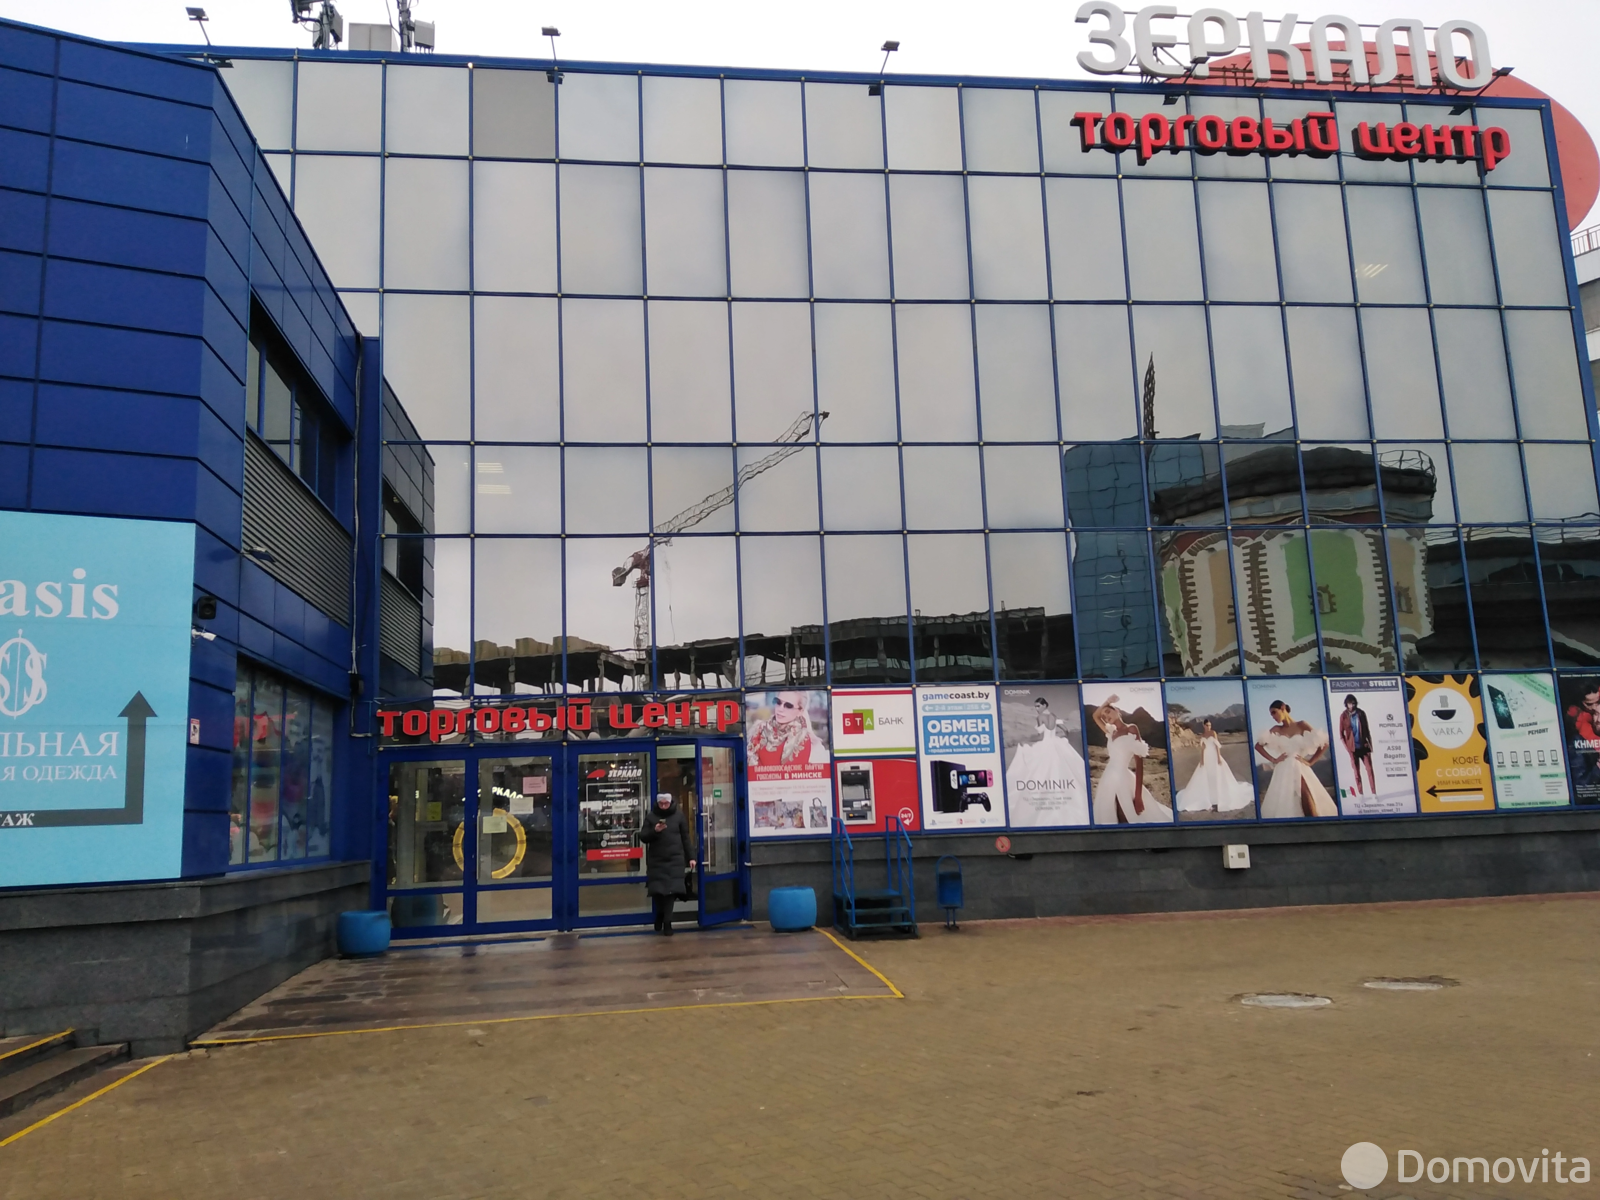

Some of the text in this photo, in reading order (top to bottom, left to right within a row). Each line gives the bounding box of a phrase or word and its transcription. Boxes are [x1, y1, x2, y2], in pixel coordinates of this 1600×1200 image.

[1075, 1, 1493, 91] ЗЕРКАЛО
[1368, 679, 1396, 687] STREET
[922, 691, 990, 702] gamecoast.by
[844, 717, 904, 727] БТА БАНК
[927, 718, 990, 733] ОБМЕН
[1432, 727, 1464, 736] VARKA
[928, 734, 991, 748] ДИСКОВ
[1574, 739, 1600, 749] KHME
[1383, 752, 1407, 760] Bagatto
[1452, 756, 1479, 765] КОФЕ
[22, 765, 118, 783] ОДЕЖДА
[607, 768, 643, 778] ЗЕРКАЛО
[791, 771, 822, 779] МИНСКЕ
[1436, 765, 1482, 777] С СОБОЙ
[1016, 779, 1076, 791] DOMINIK
[0, 812, 35, 827] АЖ
